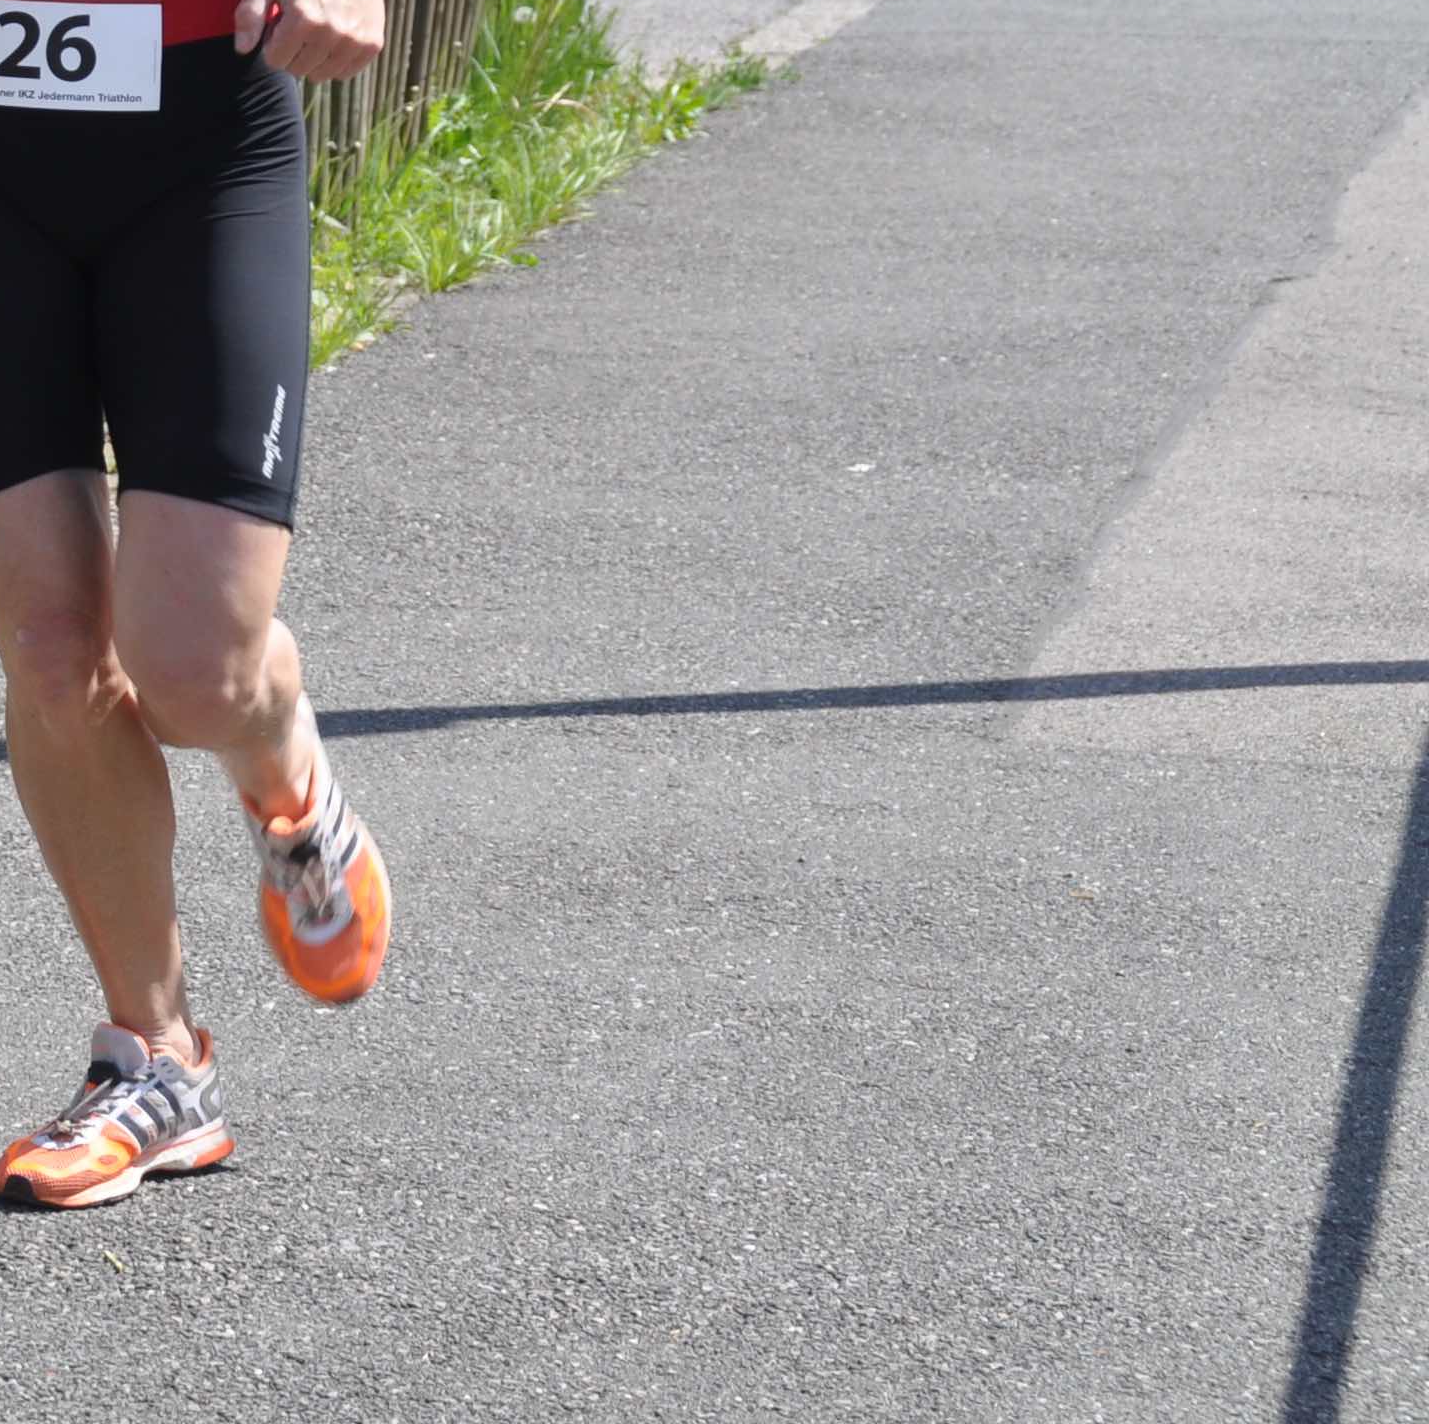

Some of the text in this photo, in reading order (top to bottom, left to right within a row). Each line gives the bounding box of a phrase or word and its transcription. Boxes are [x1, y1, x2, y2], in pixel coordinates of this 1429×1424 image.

[18, 89, 35, 100] IKZ
[38, 91, 95, 103] Jedermann
[98, 92, 142, 104] Triathlon
